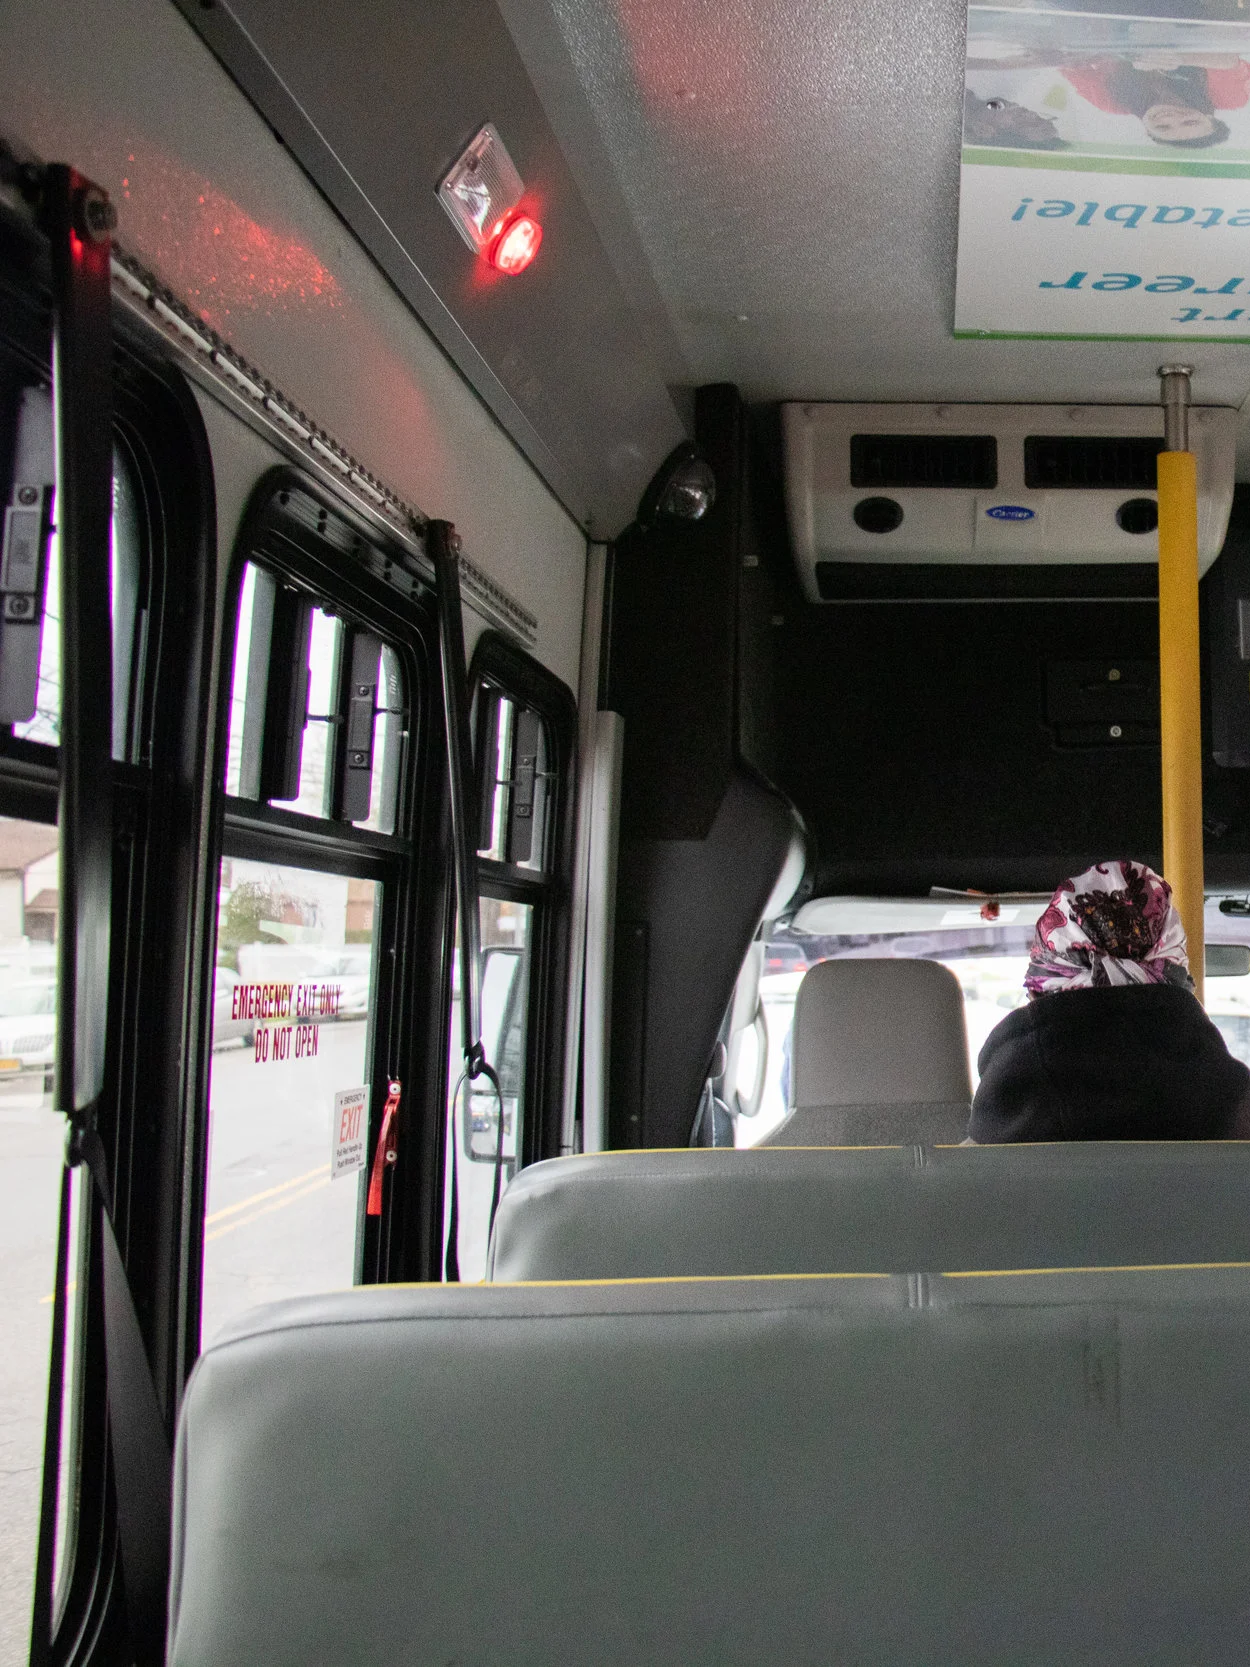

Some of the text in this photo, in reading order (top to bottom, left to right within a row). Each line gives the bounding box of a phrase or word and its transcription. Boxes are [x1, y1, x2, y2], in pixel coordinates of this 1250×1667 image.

[991, 508, 1030, 519] Carrier
[232, 984, 341, 1020] EMERGENCY EXIT ONLY
[255, 1025, 319, 1063] DO NOT OPEN
[340, 1104, 363, 1144] EXIT
